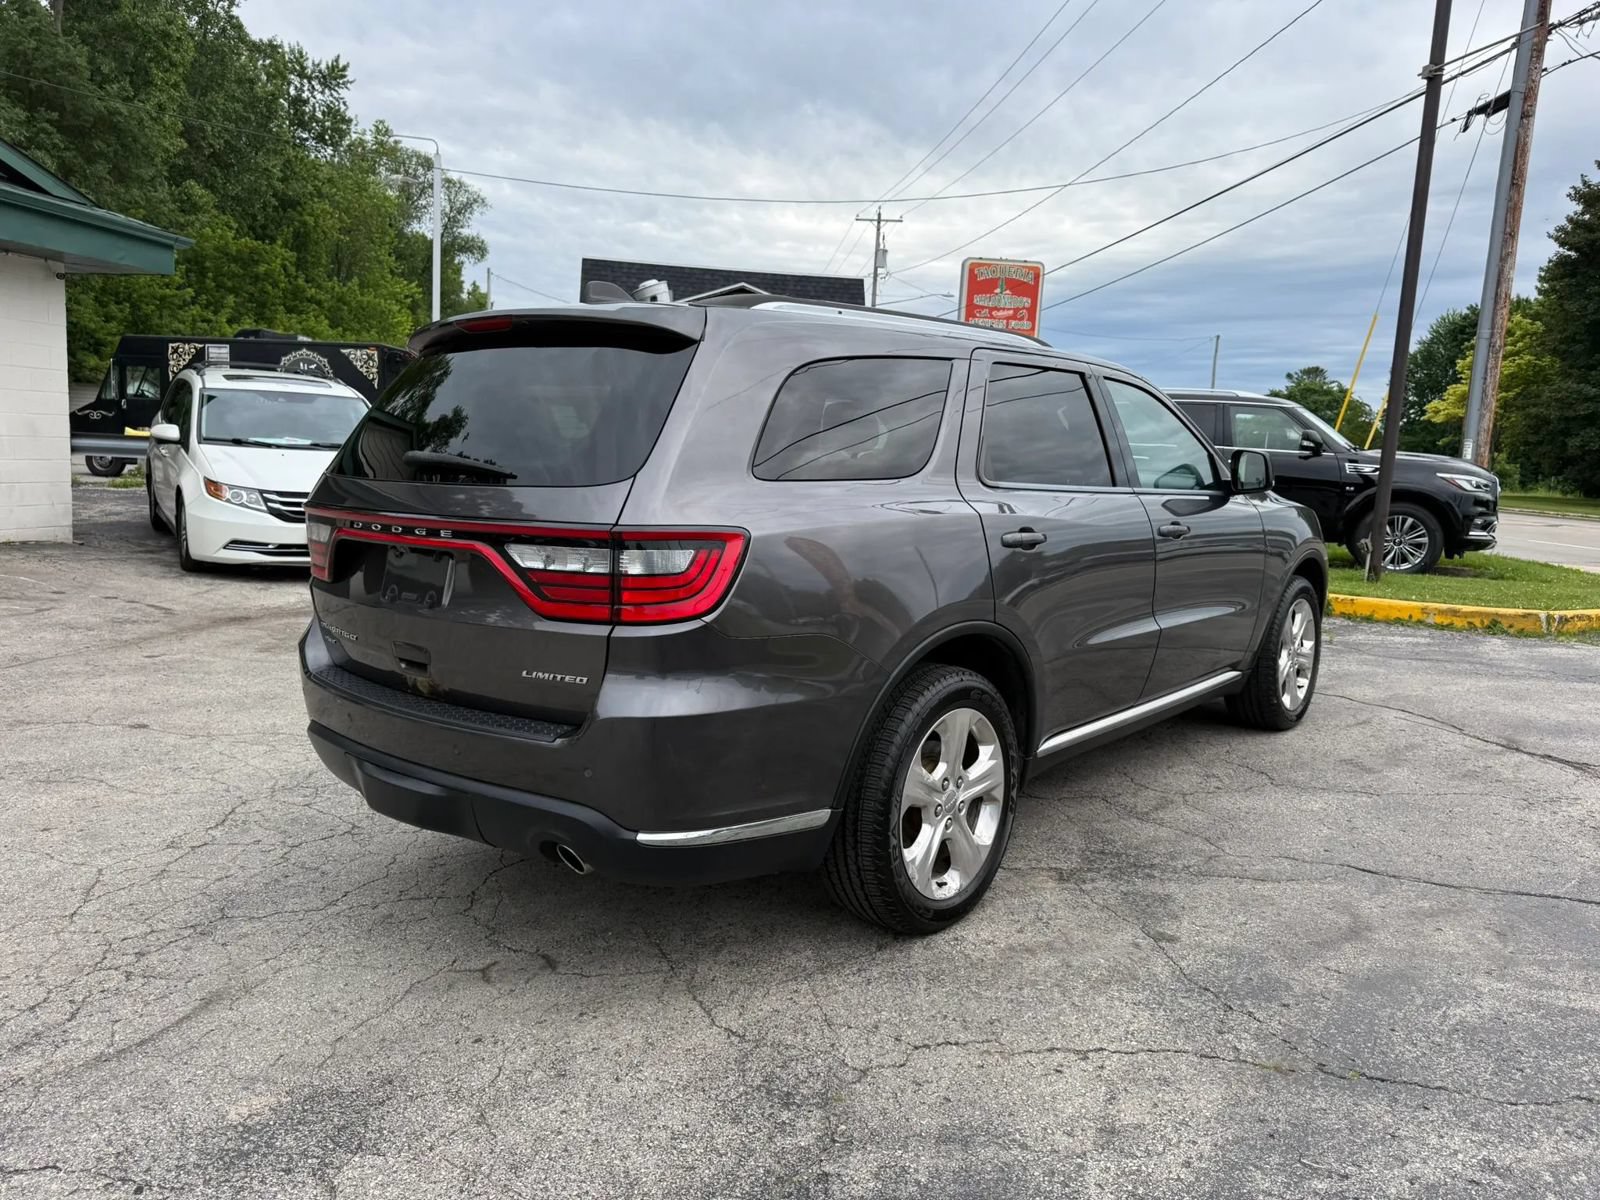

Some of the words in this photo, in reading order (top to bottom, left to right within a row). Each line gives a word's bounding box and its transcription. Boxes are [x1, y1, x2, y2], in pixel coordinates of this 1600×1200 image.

[975, 264, 1034, 285] TAQUERIA
[1008, 320, 1032, 330] FOOD
[353, 521, 453, 538] DODGE
[521, 669, 589, 685] LIMITED
